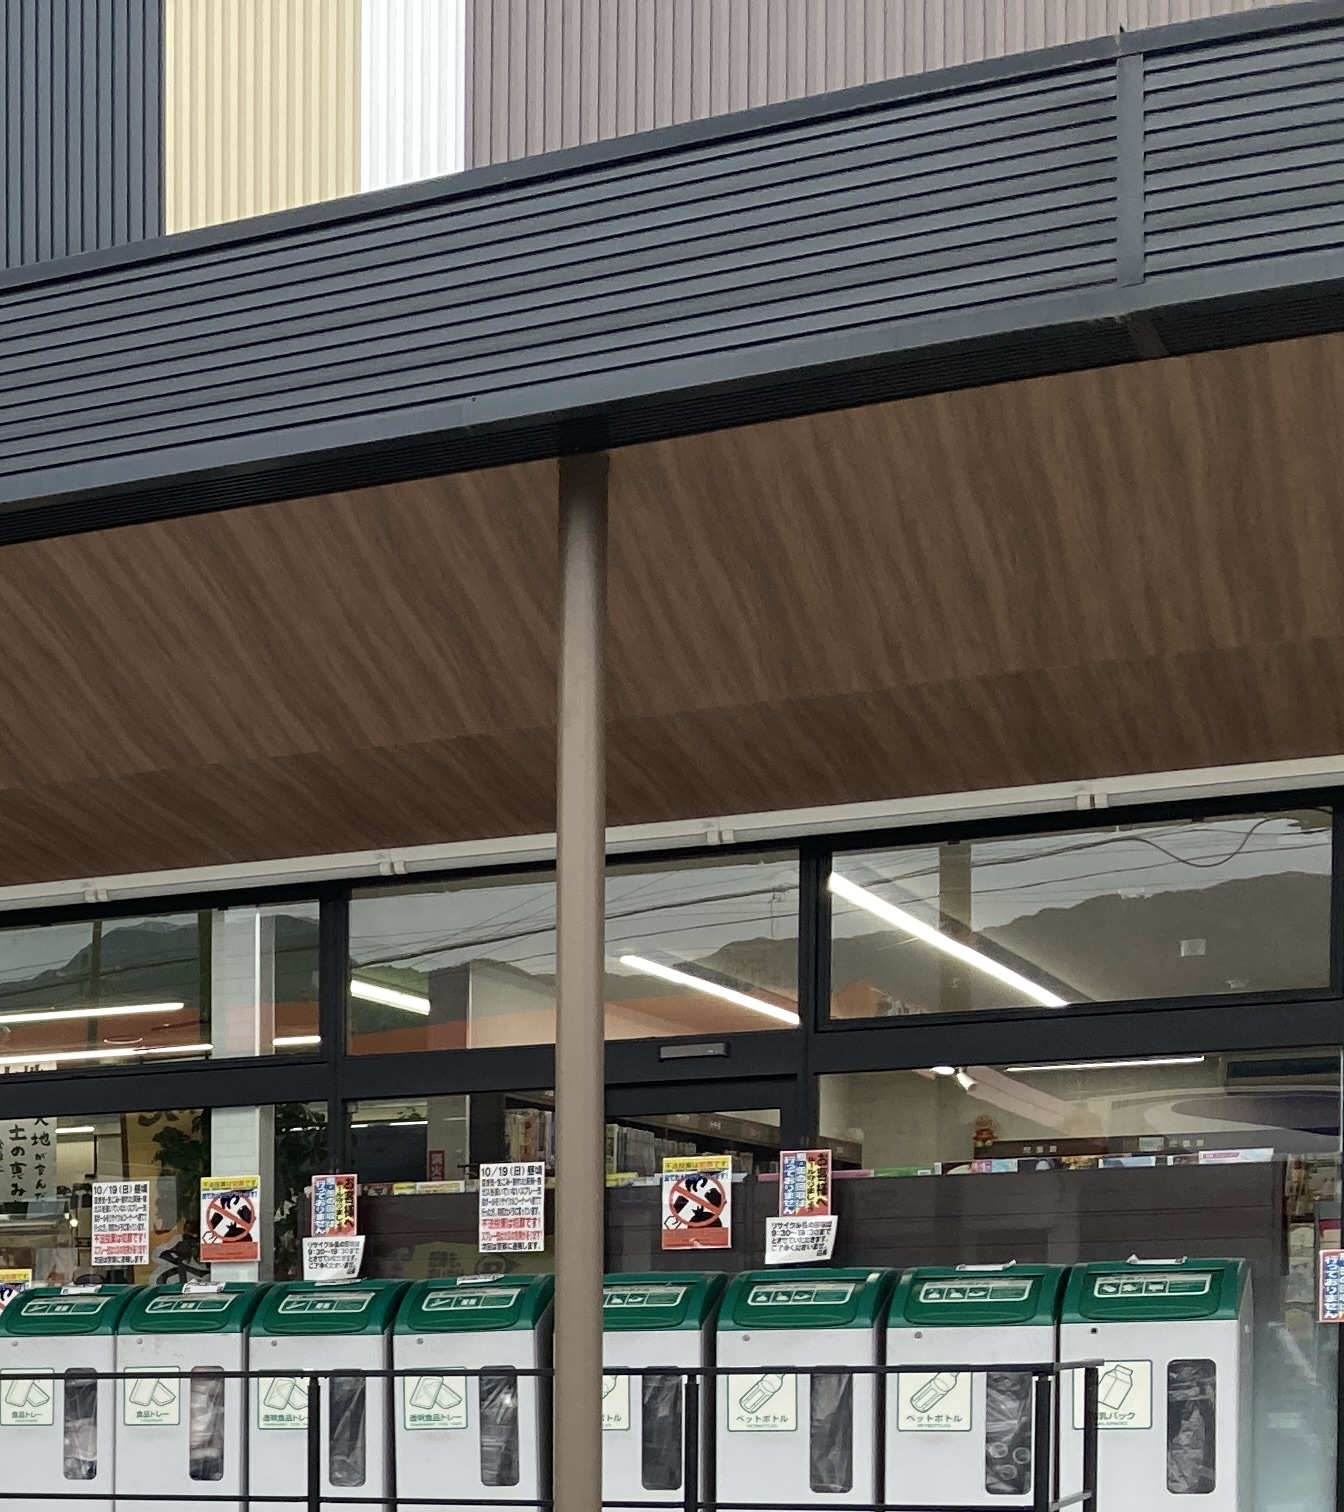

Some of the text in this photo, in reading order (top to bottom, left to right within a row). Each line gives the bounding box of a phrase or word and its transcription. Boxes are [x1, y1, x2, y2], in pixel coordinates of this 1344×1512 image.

[12, 1410, 44, 1418] 食品トレー
[136, 1410, 170, 1418] 食品トレー
[263, 1413, 309, 1422] 透明食品トレ
[409, 1413, 463, 1422] 透明食品トレー
[736, 1413, 789, 1424] ペットボトル
[907, 1413, 960, 1424] ペットボトル
[1098, 1411, 1136, 1421] 乳パック
